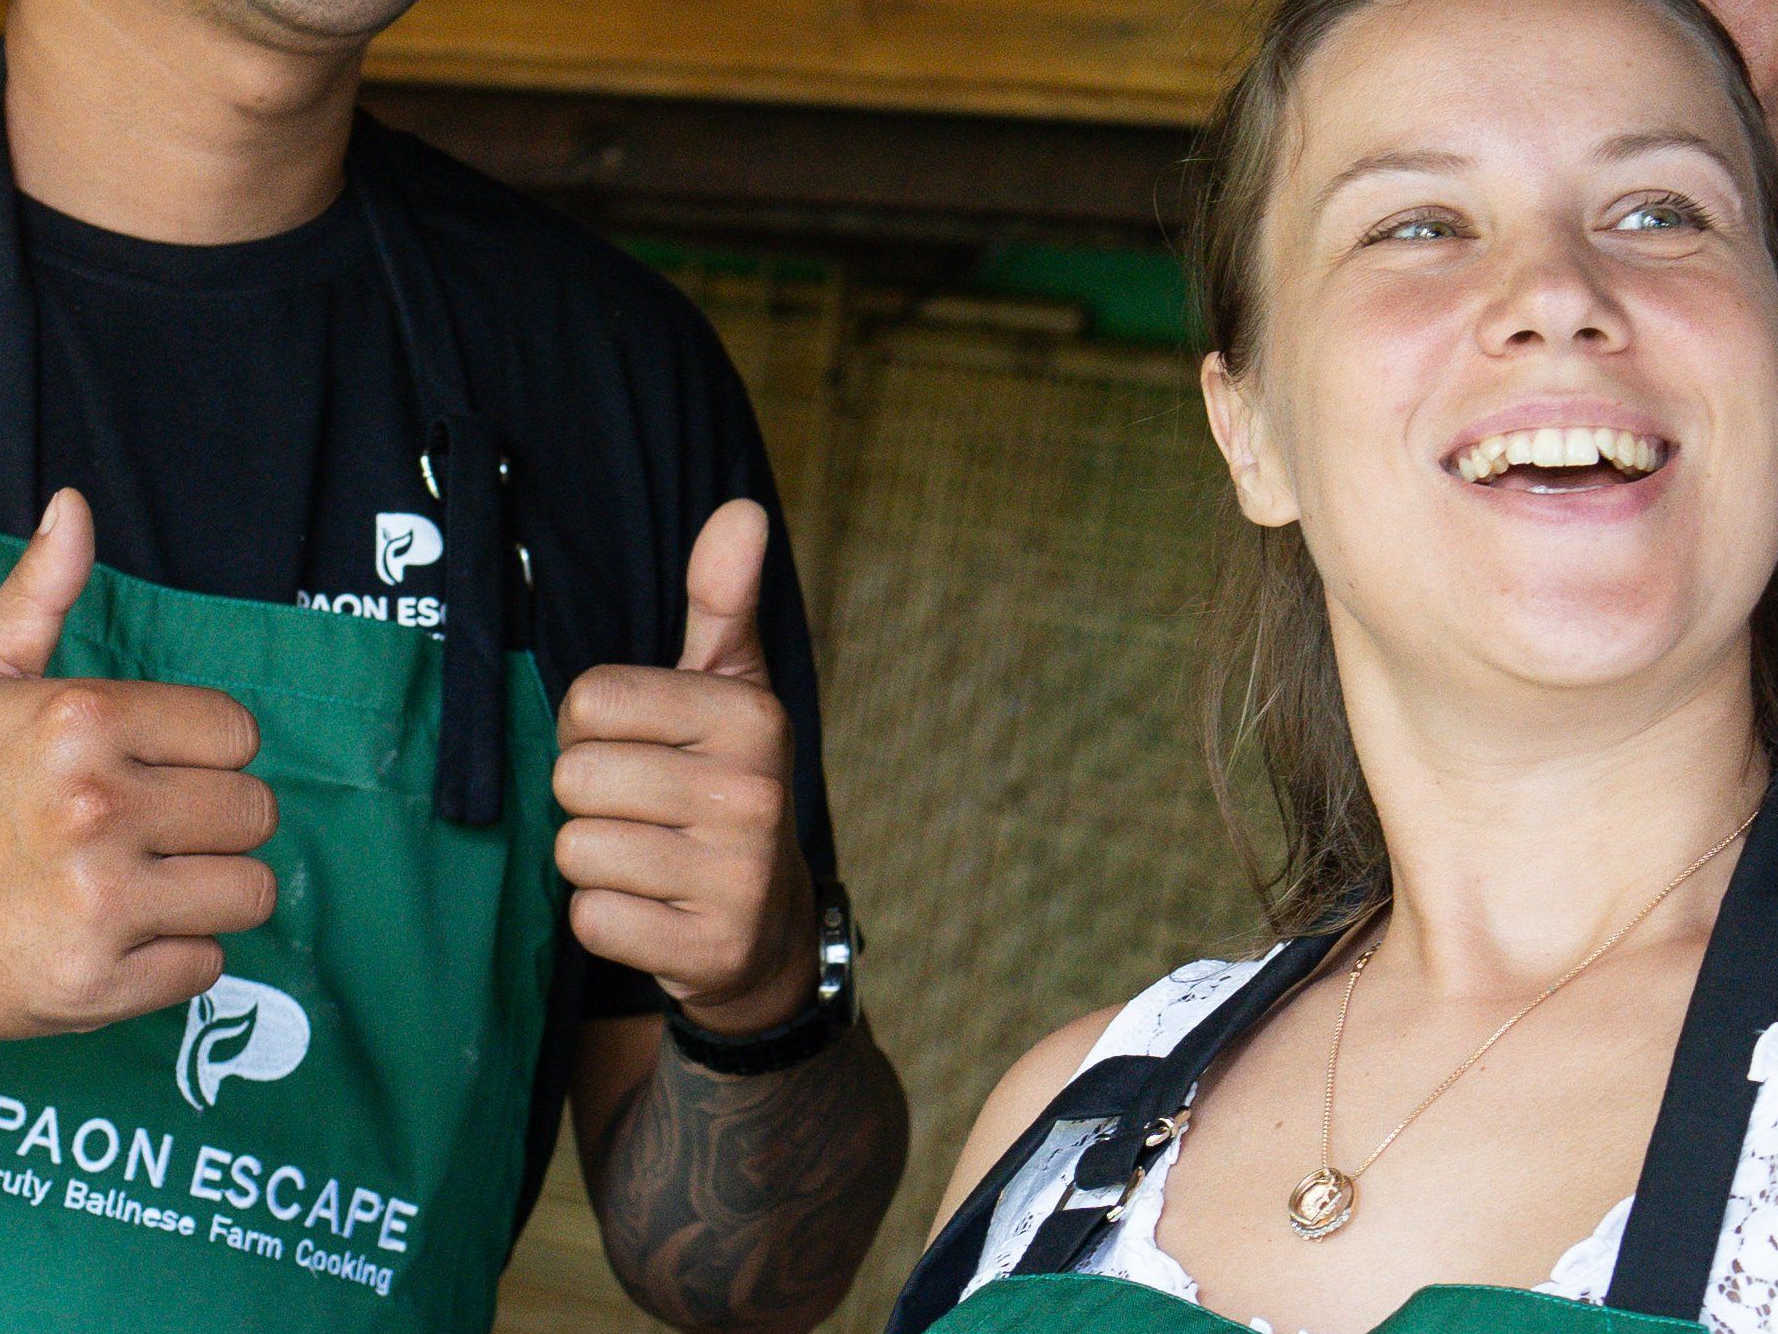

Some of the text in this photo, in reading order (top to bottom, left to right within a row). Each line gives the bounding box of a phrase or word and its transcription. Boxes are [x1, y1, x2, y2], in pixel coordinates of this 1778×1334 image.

[63, 1178, 196, 1236] Balinese
[208, 1214, 283, 1260] Farm
[294, 1238, 394, 1297] Cooking
[189, 1145, 419, 1253] ESCAPE
